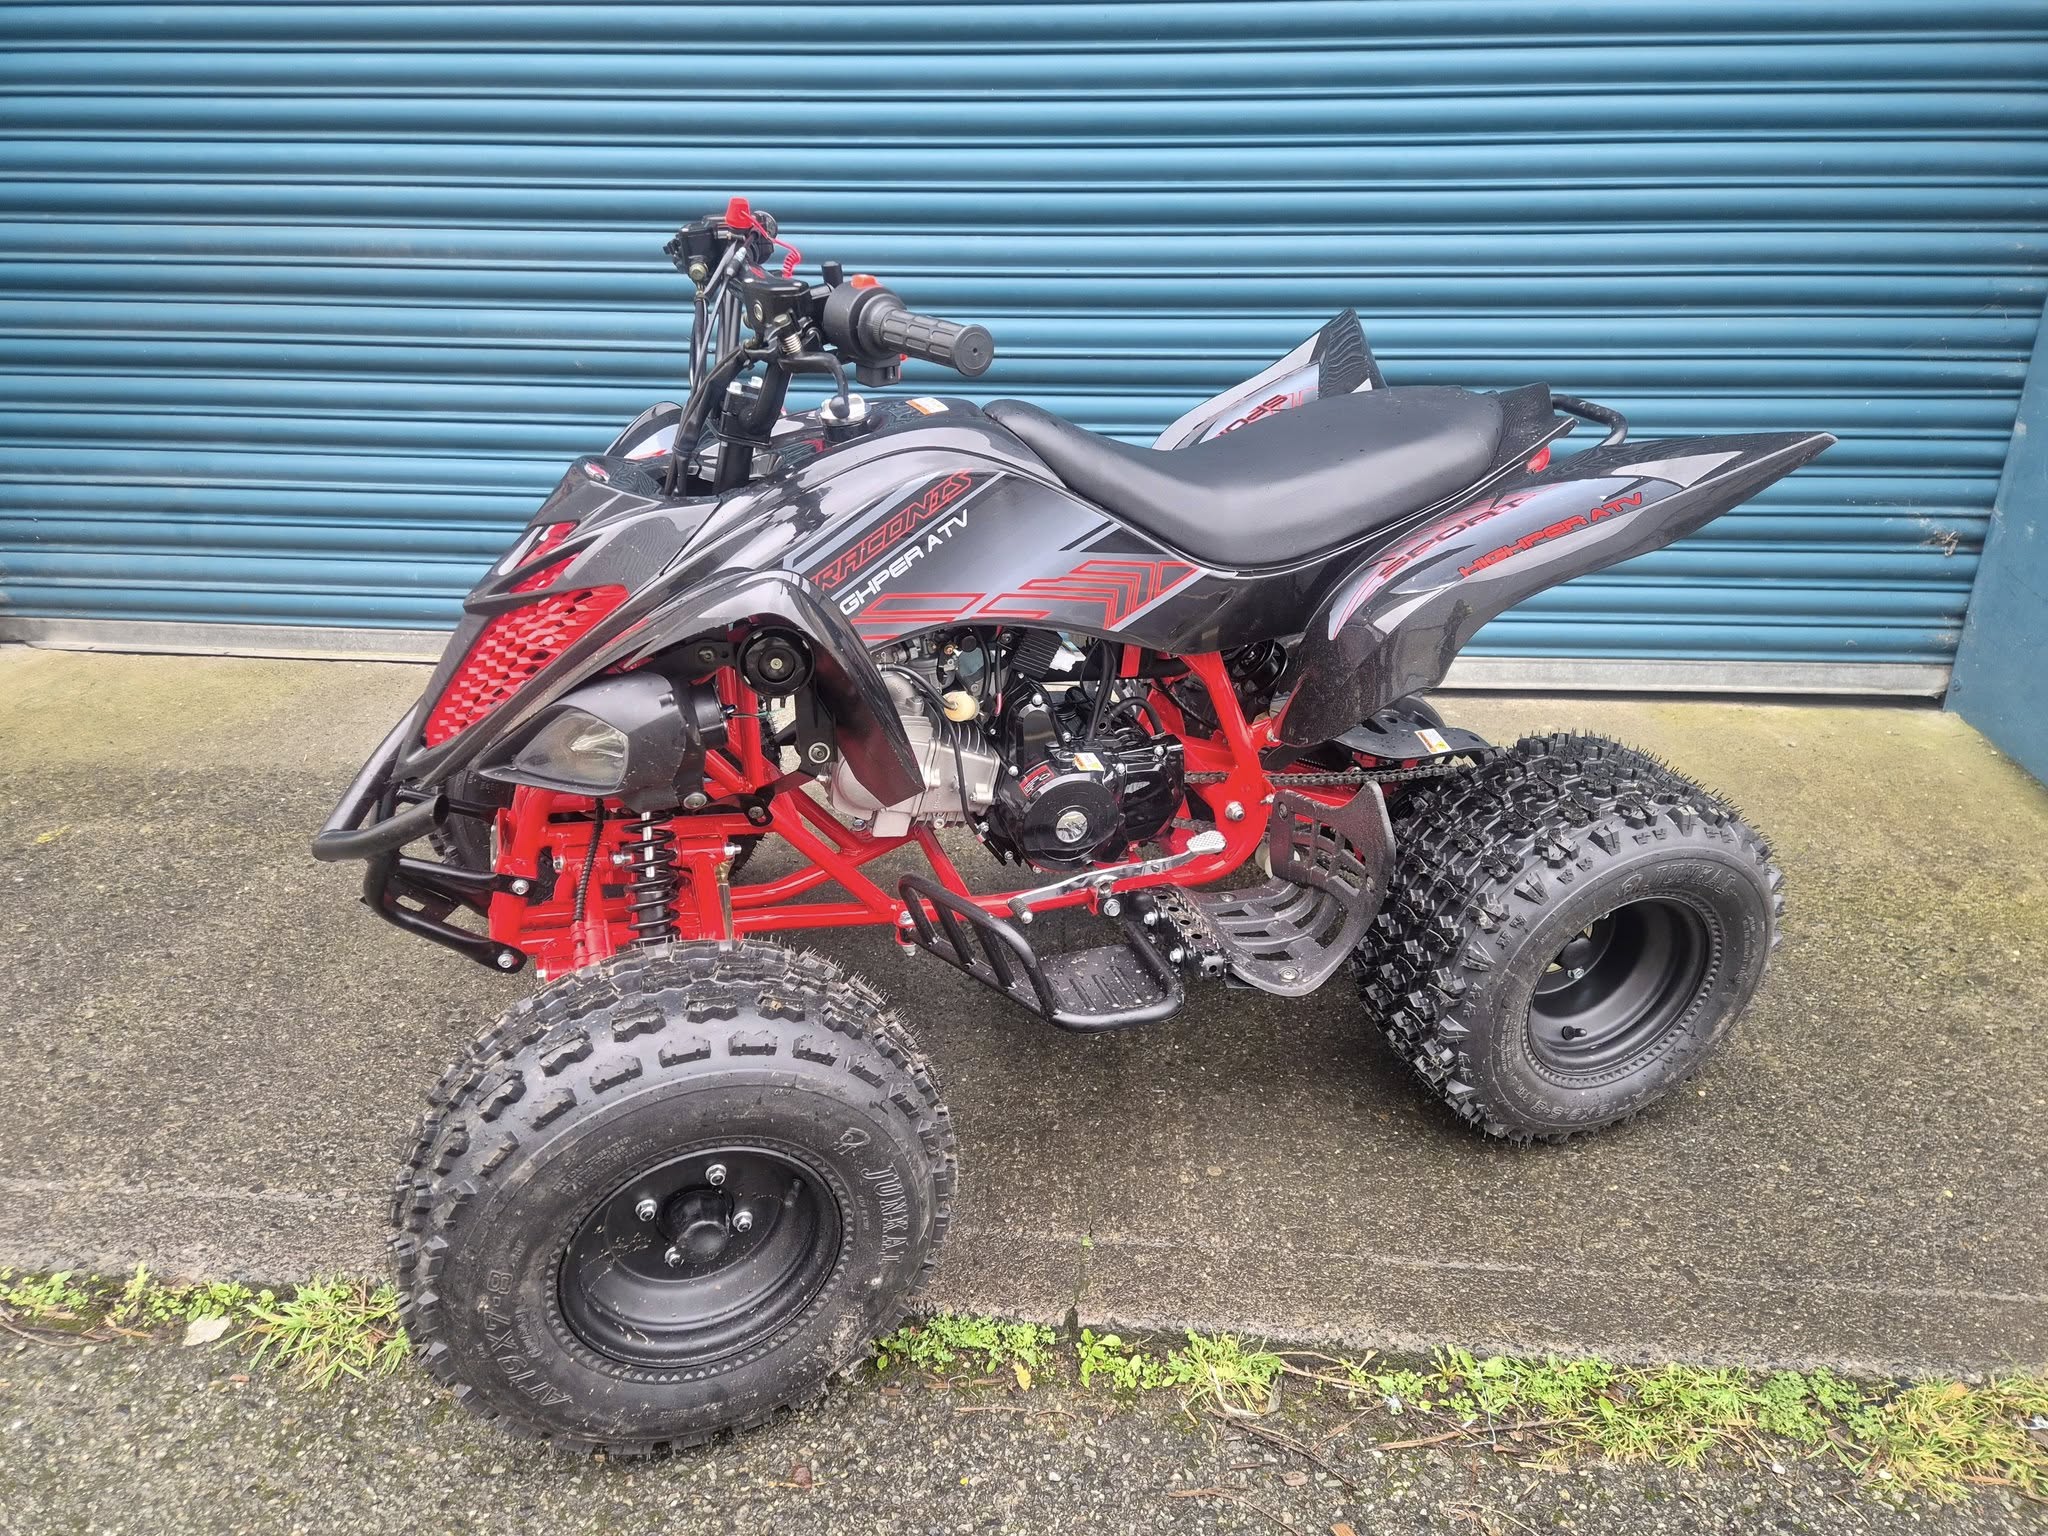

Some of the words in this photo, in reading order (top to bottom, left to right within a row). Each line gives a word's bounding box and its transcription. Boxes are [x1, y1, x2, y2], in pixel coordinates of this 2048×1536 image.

[809, 468, 972, 591] RACONIS
[927, 508, 968, 552] ATV
[1378, 496, 1532, 577] SPORT
[1457, 514, 1588, 578] HIGHPER
[1590, 491, 1642, 522] ATV
